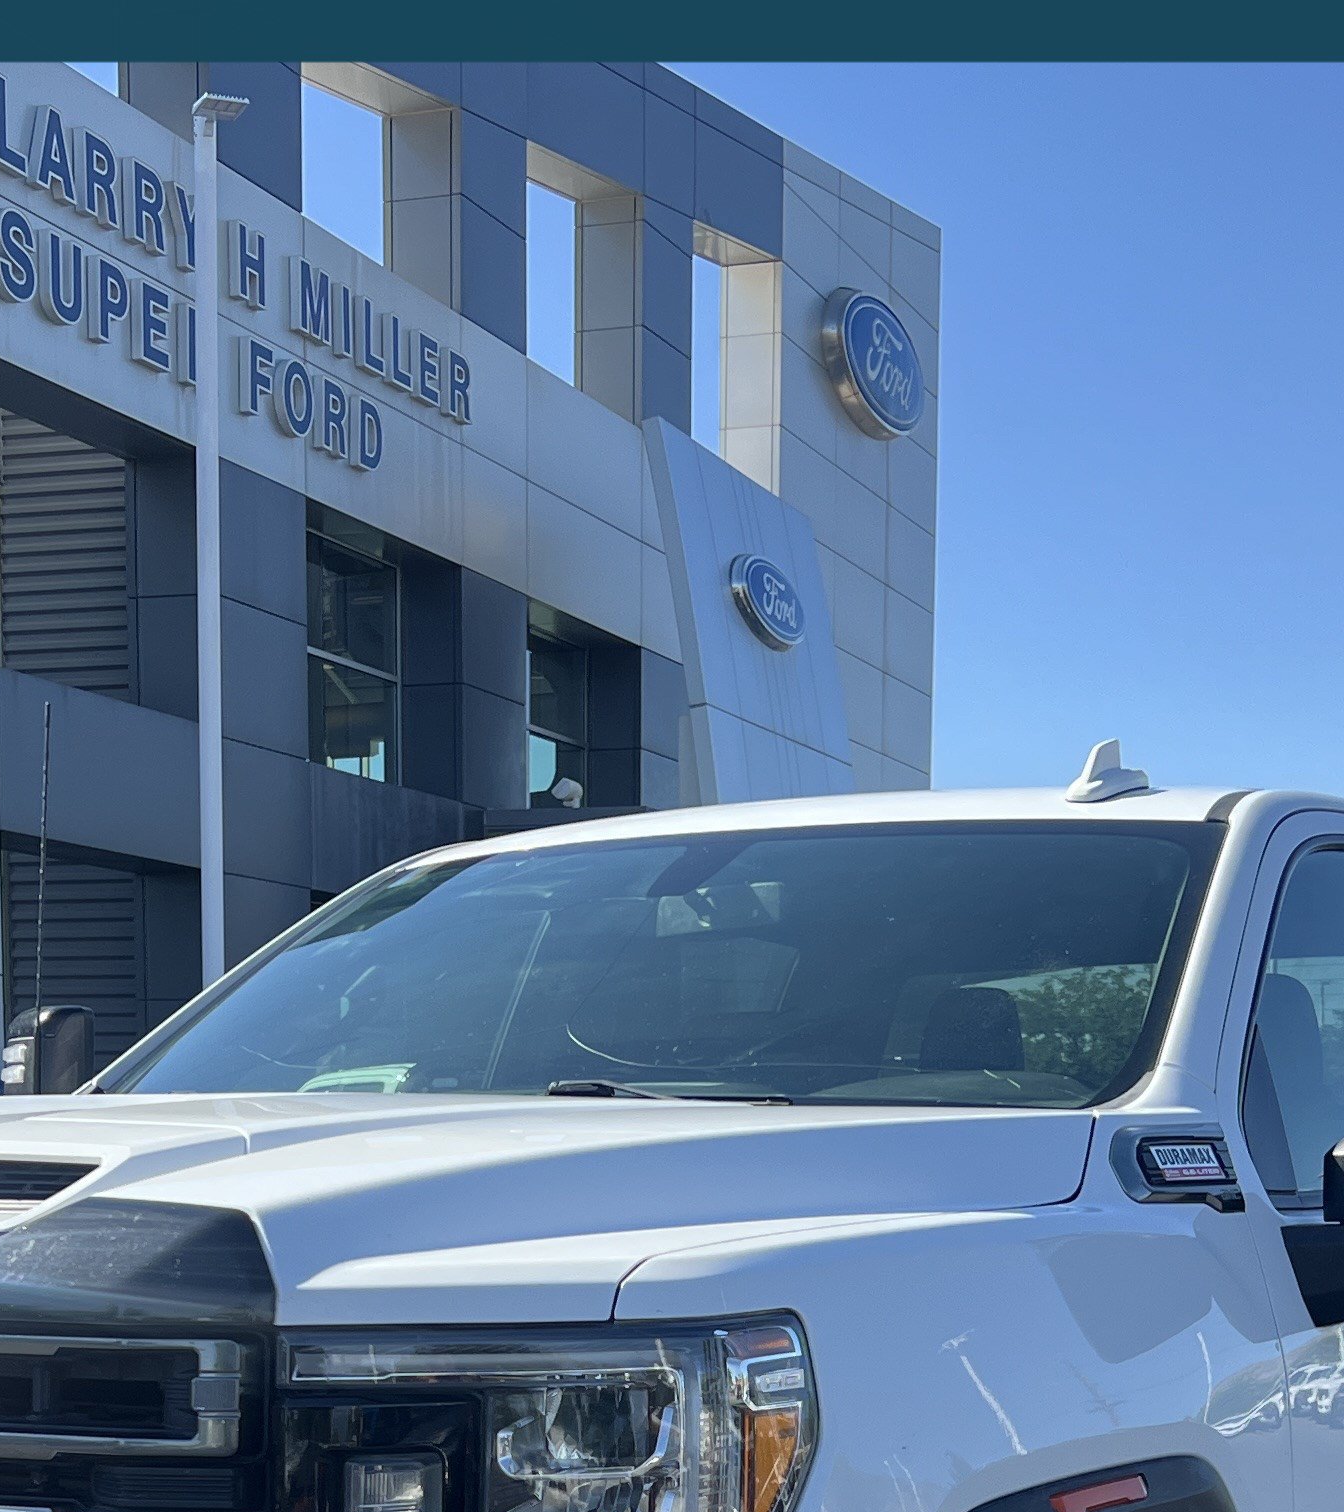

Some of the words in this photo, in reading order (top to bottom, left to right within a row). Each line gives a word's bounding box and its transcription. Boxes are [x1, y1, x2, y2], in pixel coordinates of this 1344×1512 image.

[229, 219, 267, 310] H
[289, 255, 472, 424] MILLER
[866, 317, 914, 411] Ford
[239, 336, 383, 470] FORD
[762, 571, 798, 630] Ford
[1155, 1147, 1216, 1166] DURAMAX
